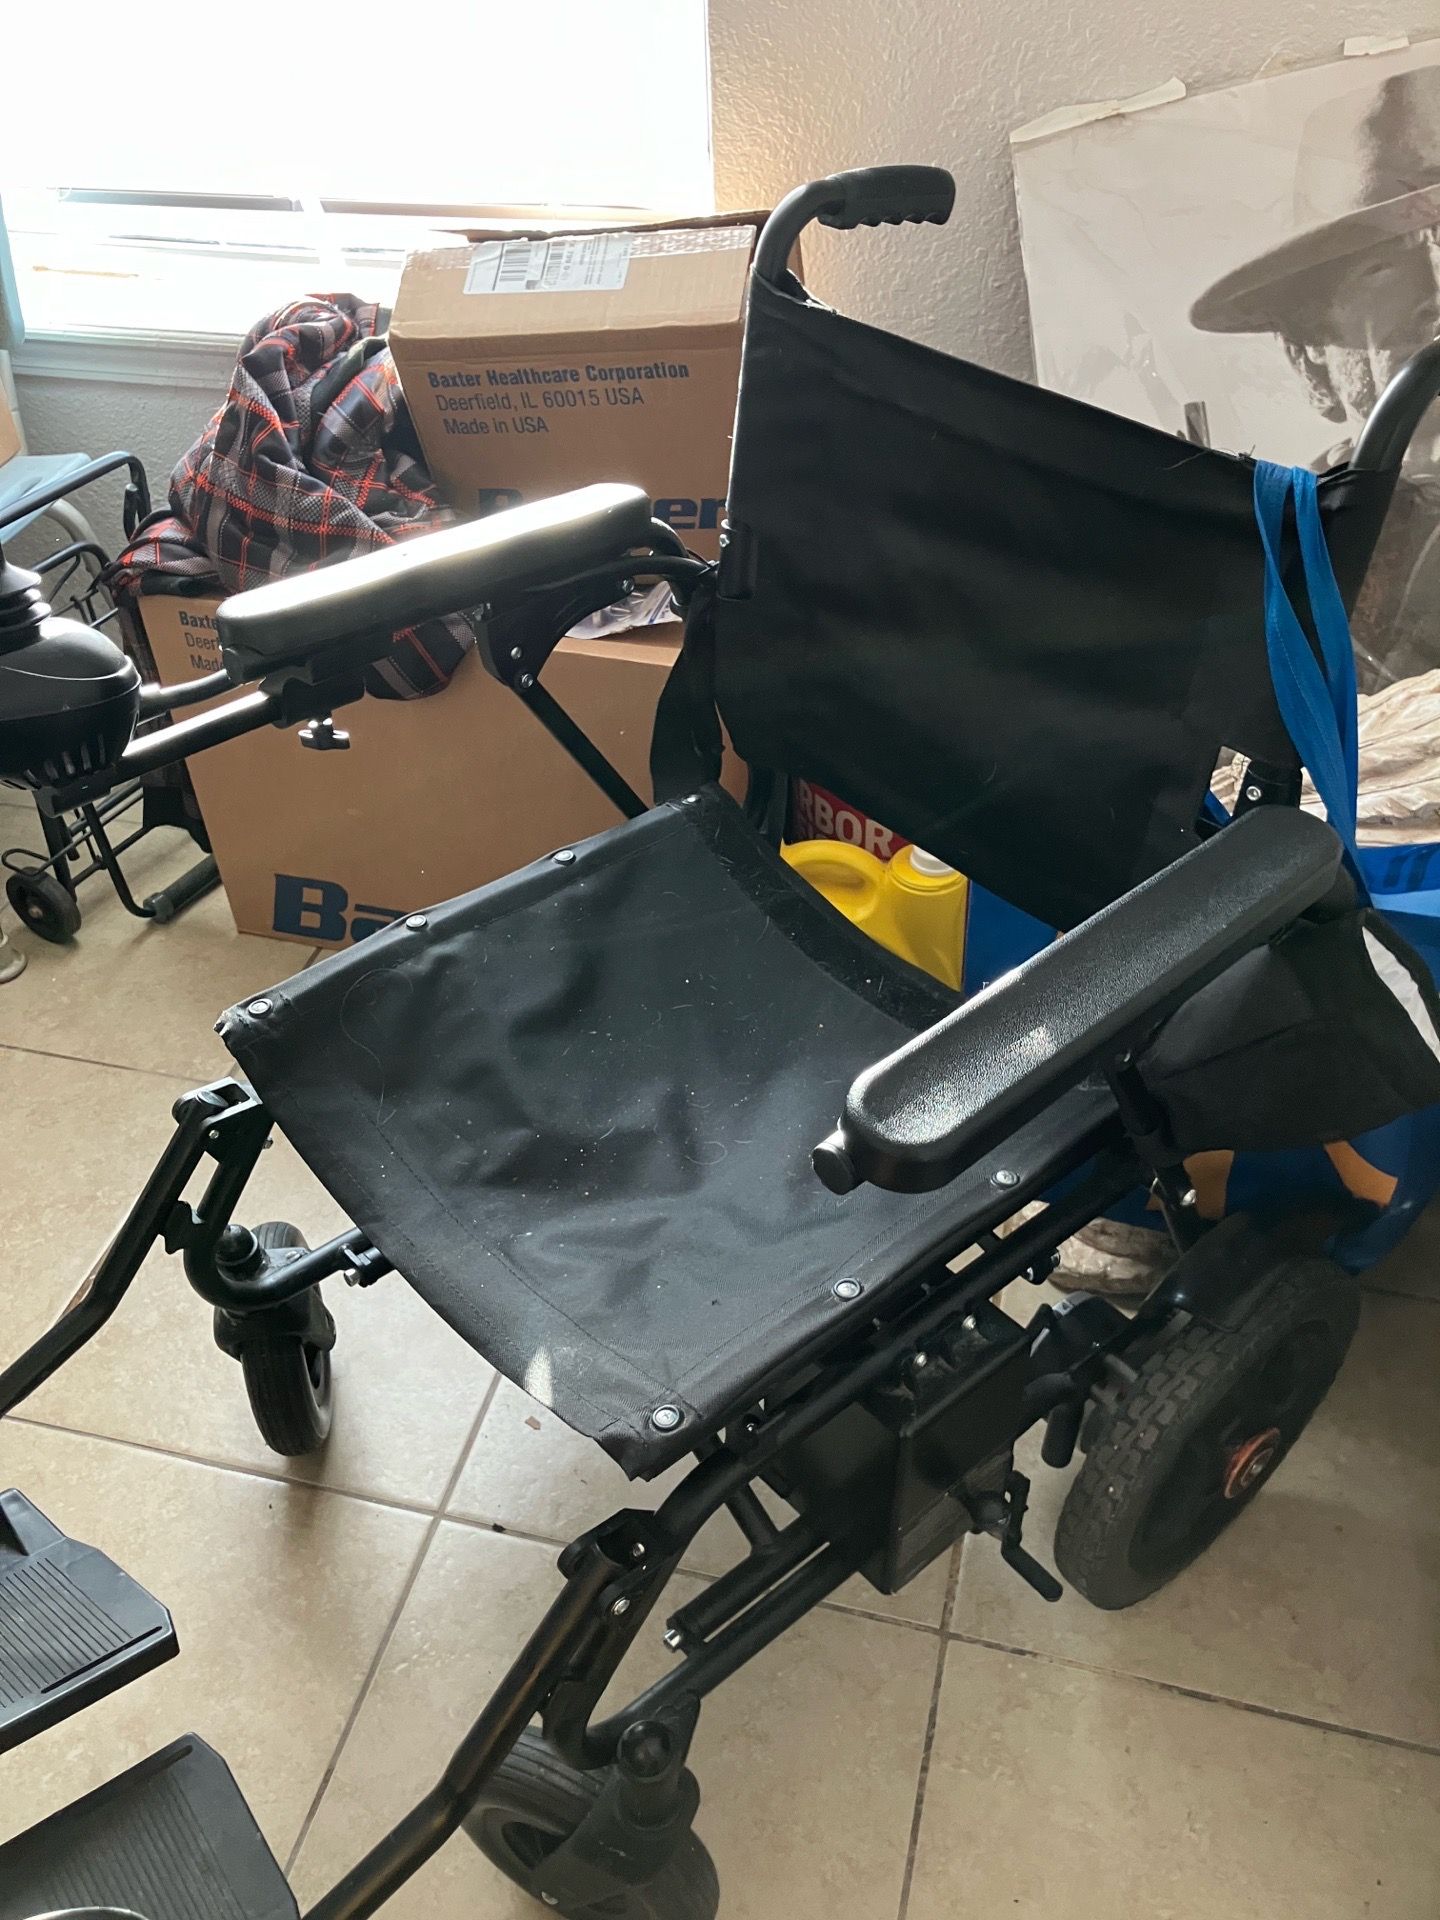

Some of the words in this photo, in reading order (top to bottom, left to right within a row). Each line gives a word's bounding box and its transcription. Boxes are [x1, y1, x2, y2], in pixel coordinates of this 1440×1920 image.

[428, 371, 482, 389] Baxter
[487, 367, 580, 386] Healthcare
[586, 361, 690, 383] Corporation
[436, 392, 518, 412] Deerfield,
[521, 392, 538, 410] IL
[543, 388, 601, 409] 60015
[605, 387, 645, 406] USA
[443, 417, 489, 436] Made
[493, 418, 509, 434] in
[513, 416, 550, 435] USA
